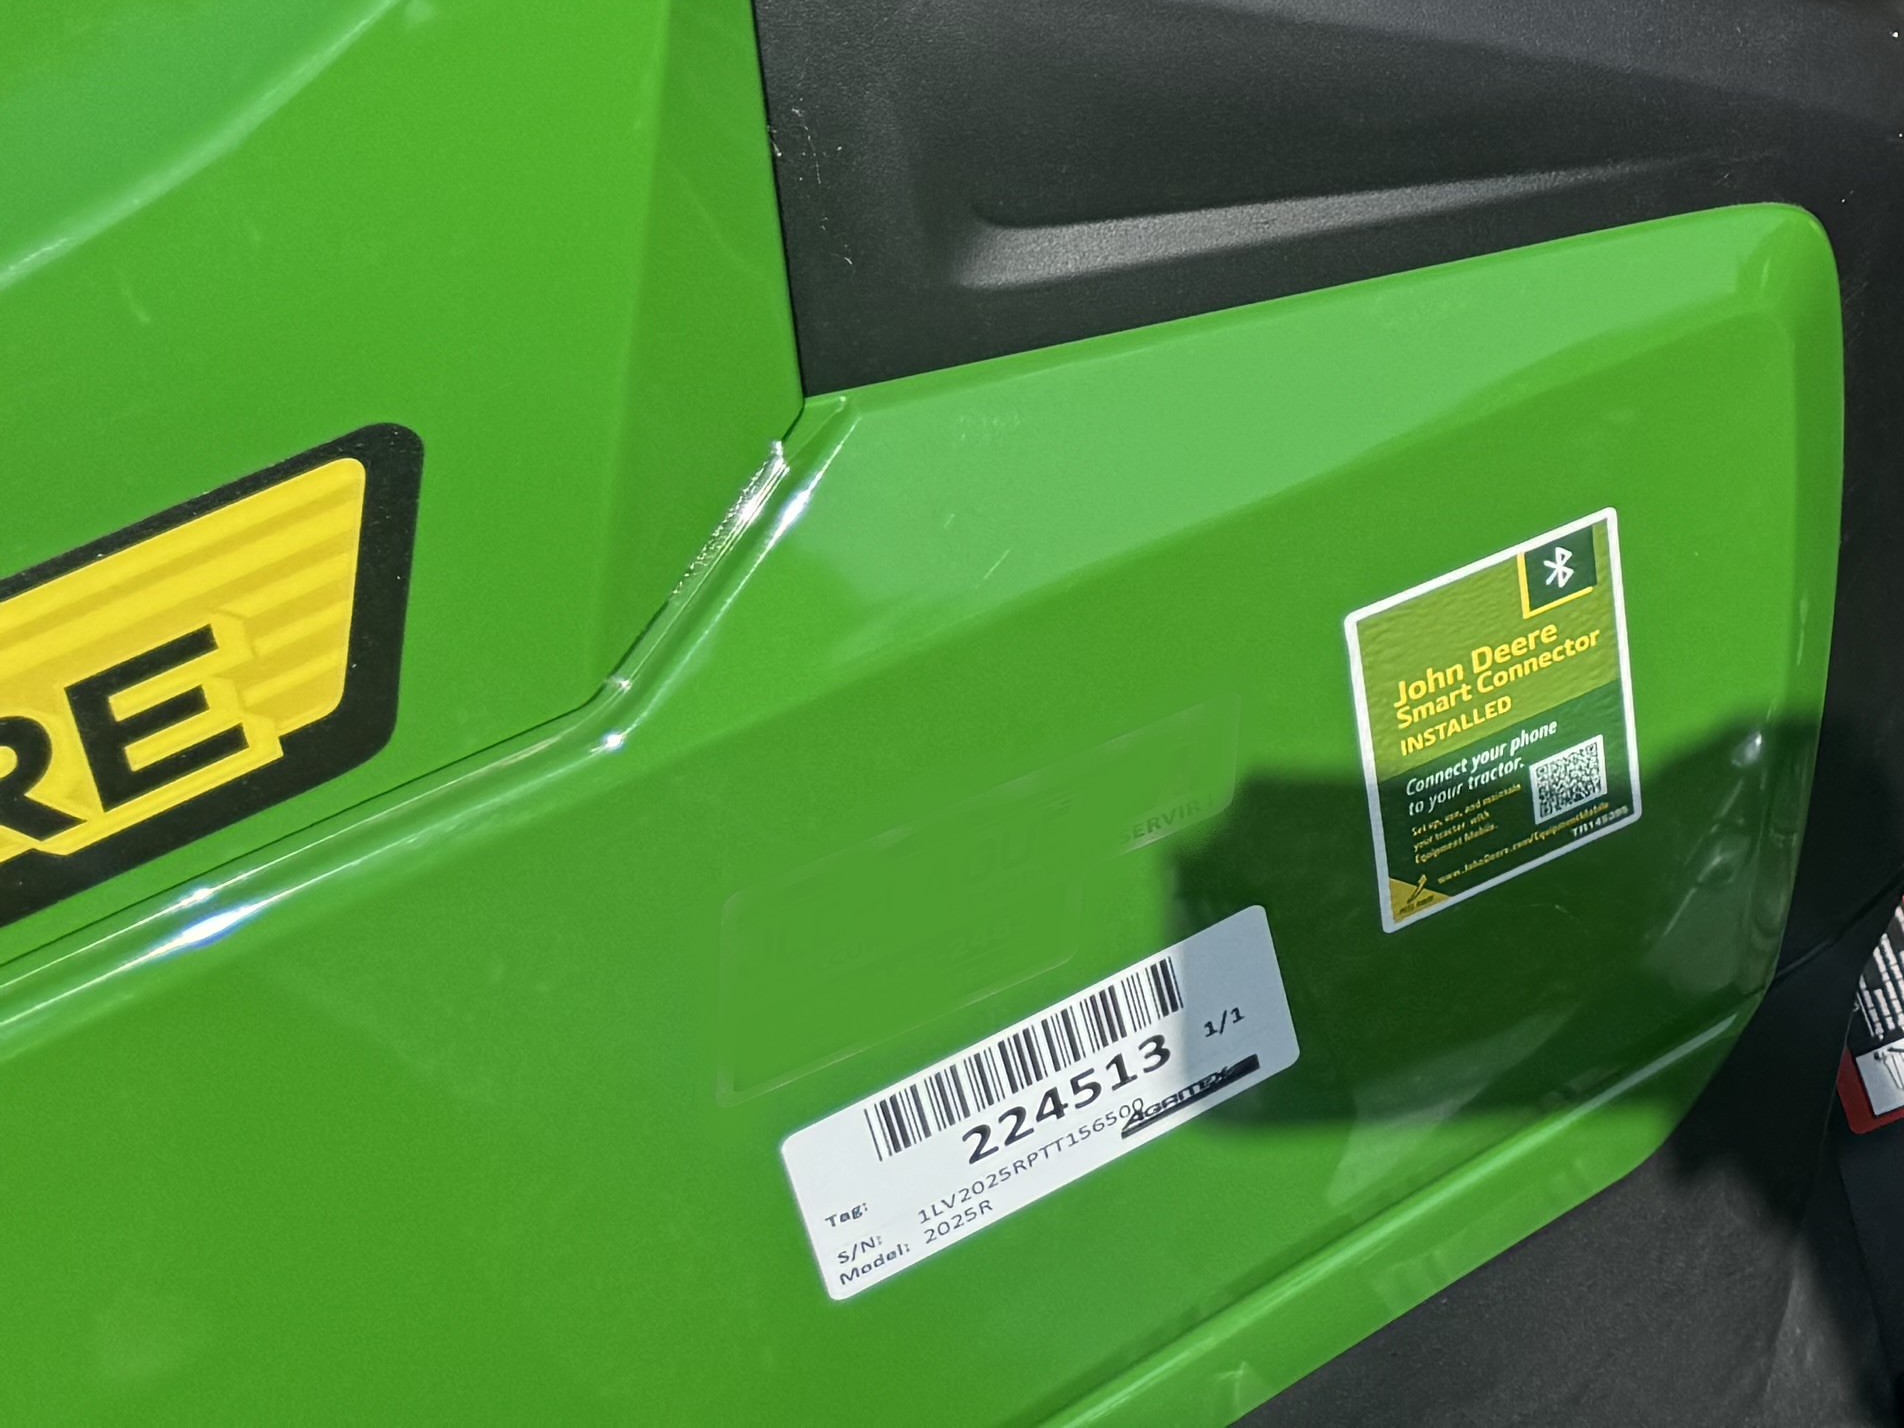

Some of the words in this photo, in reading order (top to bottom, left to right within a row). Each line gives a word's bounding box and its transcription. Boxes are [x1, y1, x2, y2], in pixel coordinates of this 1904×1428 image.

[1394, 664, 1464, 709] John
[1472, 623, 1558, 675] Deere
[1396, 682, 1472, 730] Smart
[1477, 629, 1600, 695] Connector
[1401, 695, 1512, 757] INSTALLED
[1405, 758, 1468, 797] Connect
[1470, 741, 1510, 774] your
[1510, 718, 1558, 757] phone
[1408, 800, 1424, 817] to
[1428, 782, 1463, 813] your
[1468, 756, 1525, 790] tractor.
[962, 1033, 1172, 1165] 224513
[1204, 1006, 1246, 1038] 1/1
[825, 1202, 868, 1228] Tag:
[837, 1235, 883, 1265] S/N:
[917, 1097, 1144, 1225] 1LV2025RPTT156500
[839, 1243, 911, 1286] Model:
[923, 1199, 993, 1245] 2025R
